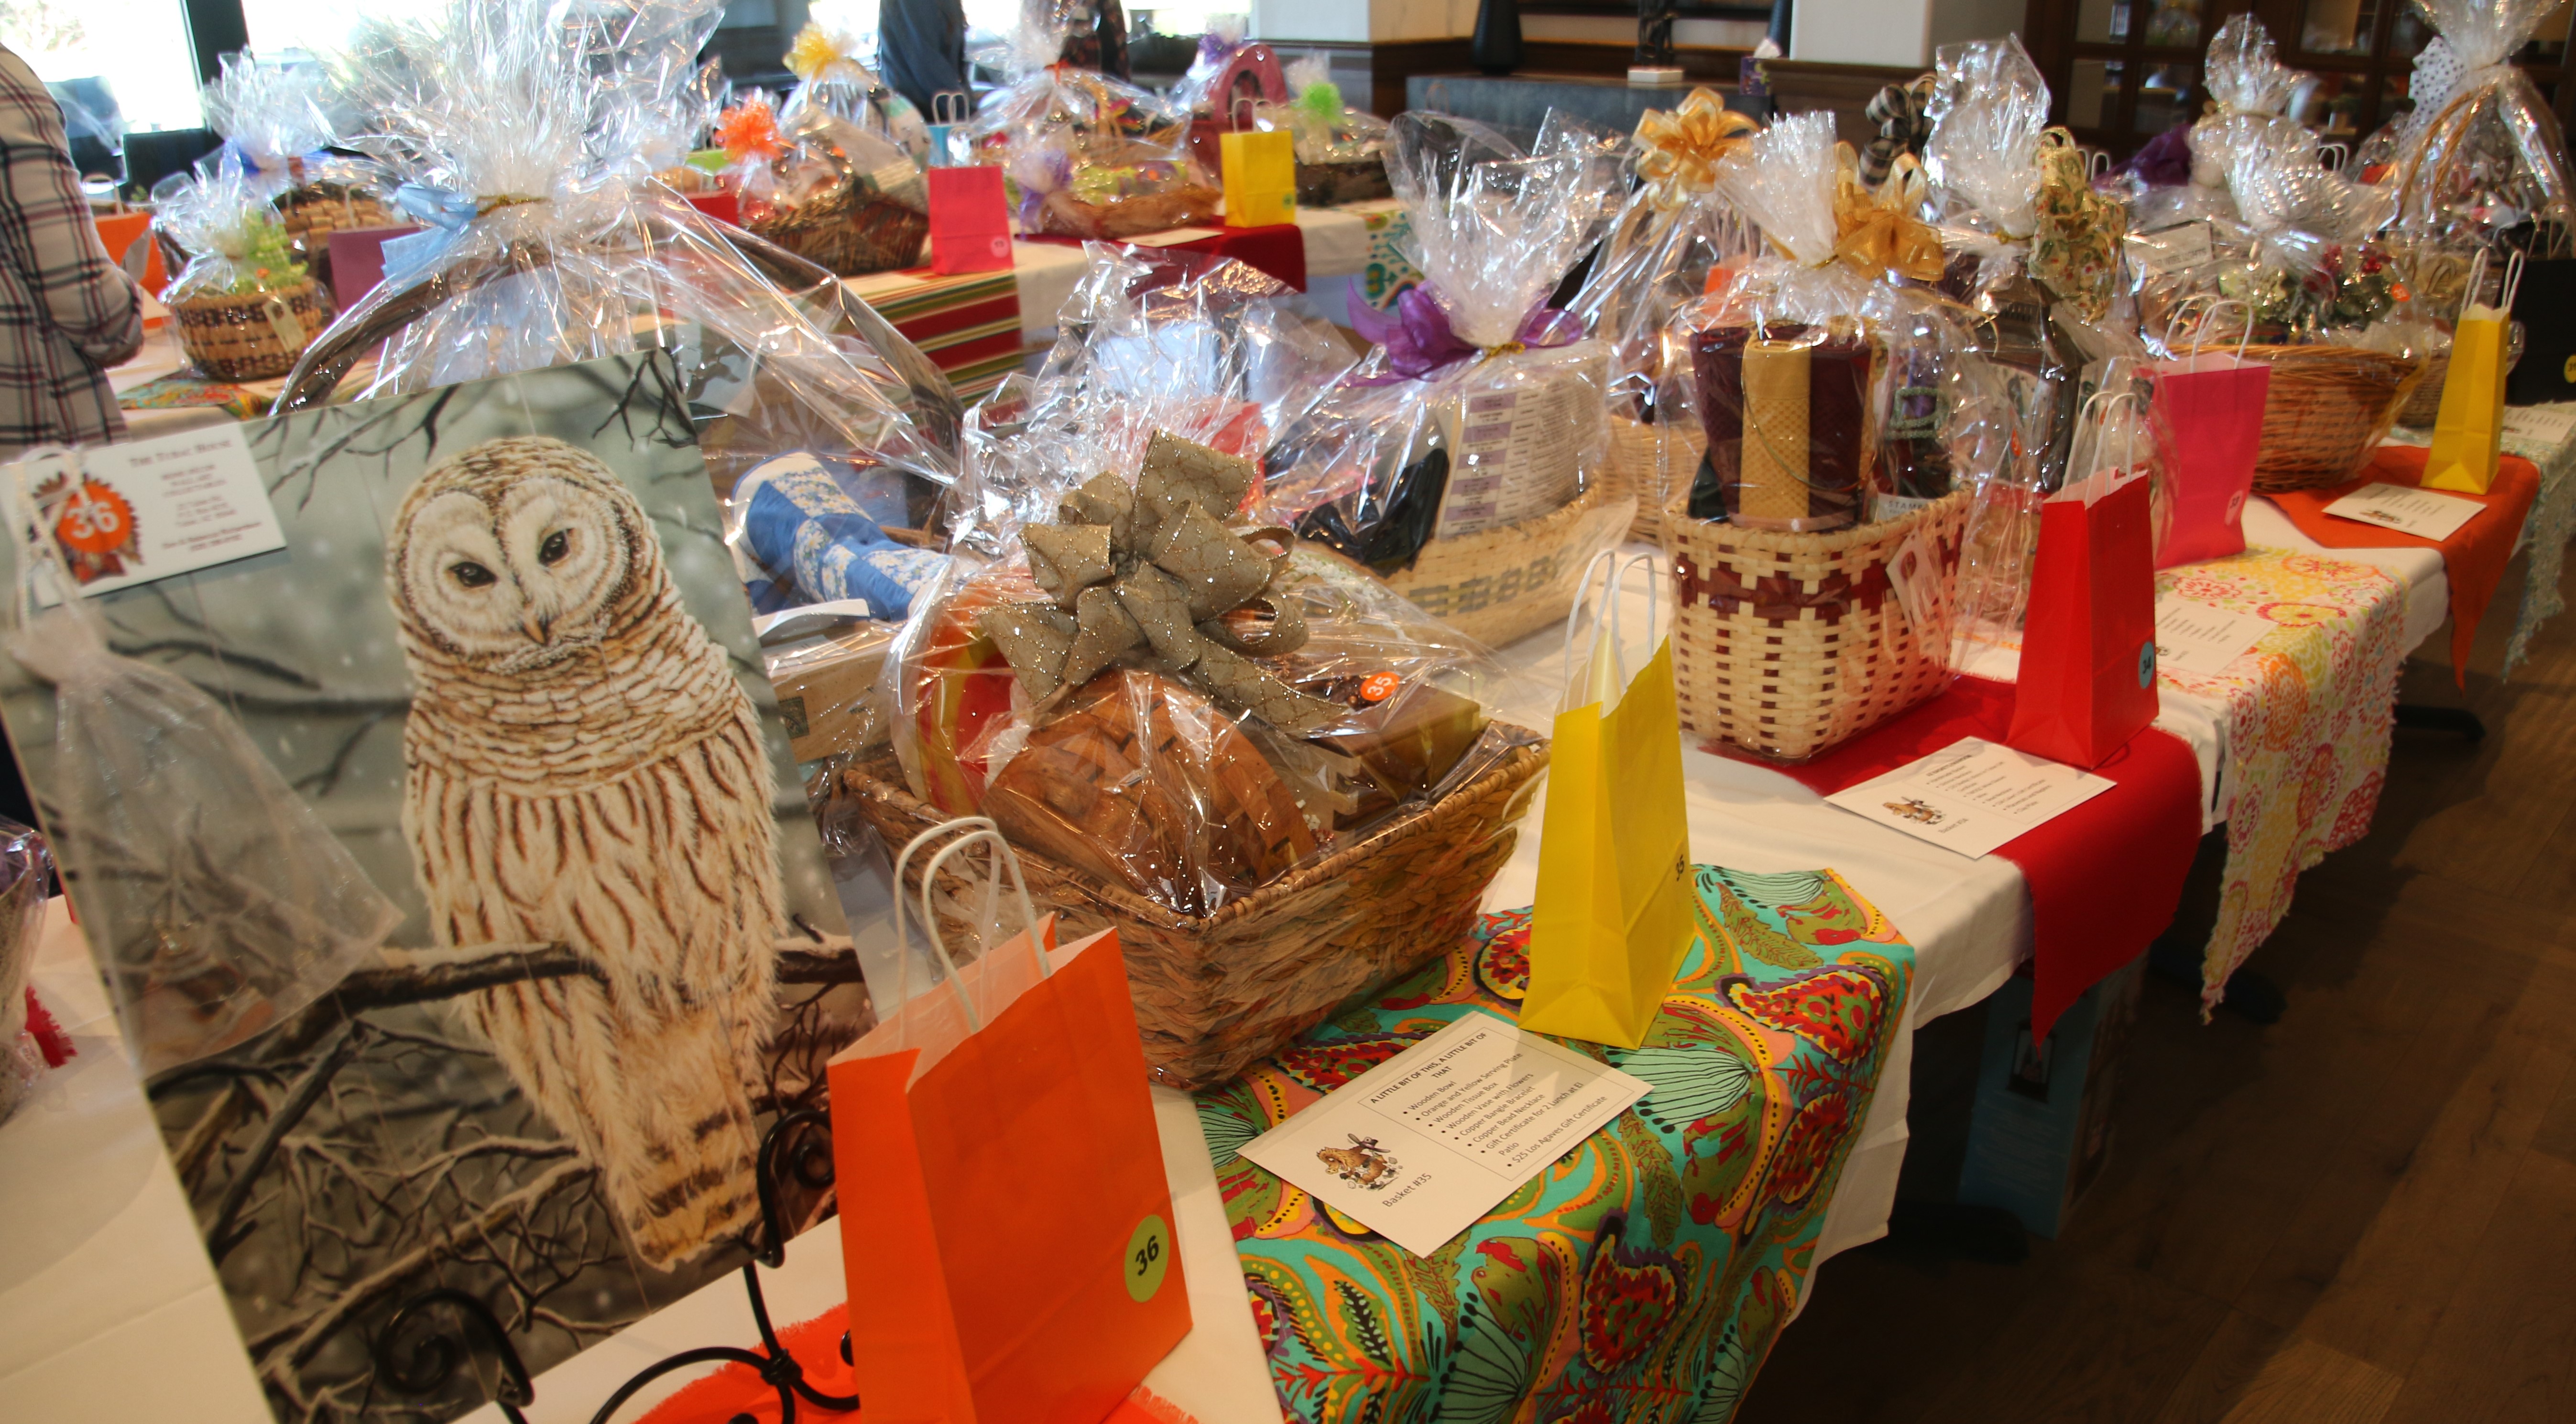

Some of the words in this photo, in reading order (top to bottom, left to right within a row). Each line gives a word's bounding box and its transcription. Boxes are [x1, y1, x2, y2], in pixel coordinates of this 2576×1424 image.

[66, 501, 120, 539] 36
[2143, 655, 2151, 674] 34
[1367, 676, 1392, 696] 35
[1375, 1084, 1401, 1099] LITTLE
[1397, 1077, 1412, 1086] BIT
[1419, 1062, 1441, 1073] THIS,
[1443, 1045, 1467, 1059] LITTLE
[1464, 1038, 1478, 1046] BIT
[1421, 1100, 1449, 1117] Orange
[1447, 1091, 1462, 1101] and
[1458, 1078, 1483, 1092] Yellow
[1480, 1063, 1508, 1079] Serving
[1503, 1053, 1523, 1064] Plate
[1431, 1066, 1452, 1078] THAT
[1407, 1092, 1440, 1110] Wooden
[1436, 1080, 1457, 1093] Bowl
[1432, 1104, 1465, 1123] Wooden
[1461, 1090, 1486, 1104] Tissue
[1482, 1082, 1499, 1091] Box
[1445, 1110, 1478, 1129] Wooden
[1474, 1099, 1494, 1110] Vase
[1492, 1089, 1510, 1100] with
[1506, 1073, 1534, 1091] Flowers
[1459, 1118, 1486, 1136] Copper
[1483, 1104, 1509, 1120] Bangle
[1505, 1086, 1536, 1105] Bracelet
[1473, 1124, 1499, 1142] Copper
[1496, 1112, 1517, 1126] Bead
[1513, 1094, 1545, 1114] Necklace
[1486, 1139, 1503, 1149] Gift
[1499, 1116, 1536, 1140] Certificate
[1531, 1109, 1545, 1117] for
[1547, 1092, 1571, 1107] Lunch
[1512, 1152, 1528, 1163] $25
[1525, 1143, 1541, 1153] Los
[1538, 1127, 1564, 1145] Agaves
[1560, 1118, 1577, 1128] Gift
[1572, 1096, 1607, 1119] Certificate
[1498, 1142, 1519, 1156] Patio
[1382, 1185, 1416, 1207] Basket
[1412, 1173, 1432, 1186] #35
[1135, 1235, 1159, 1276] 36
